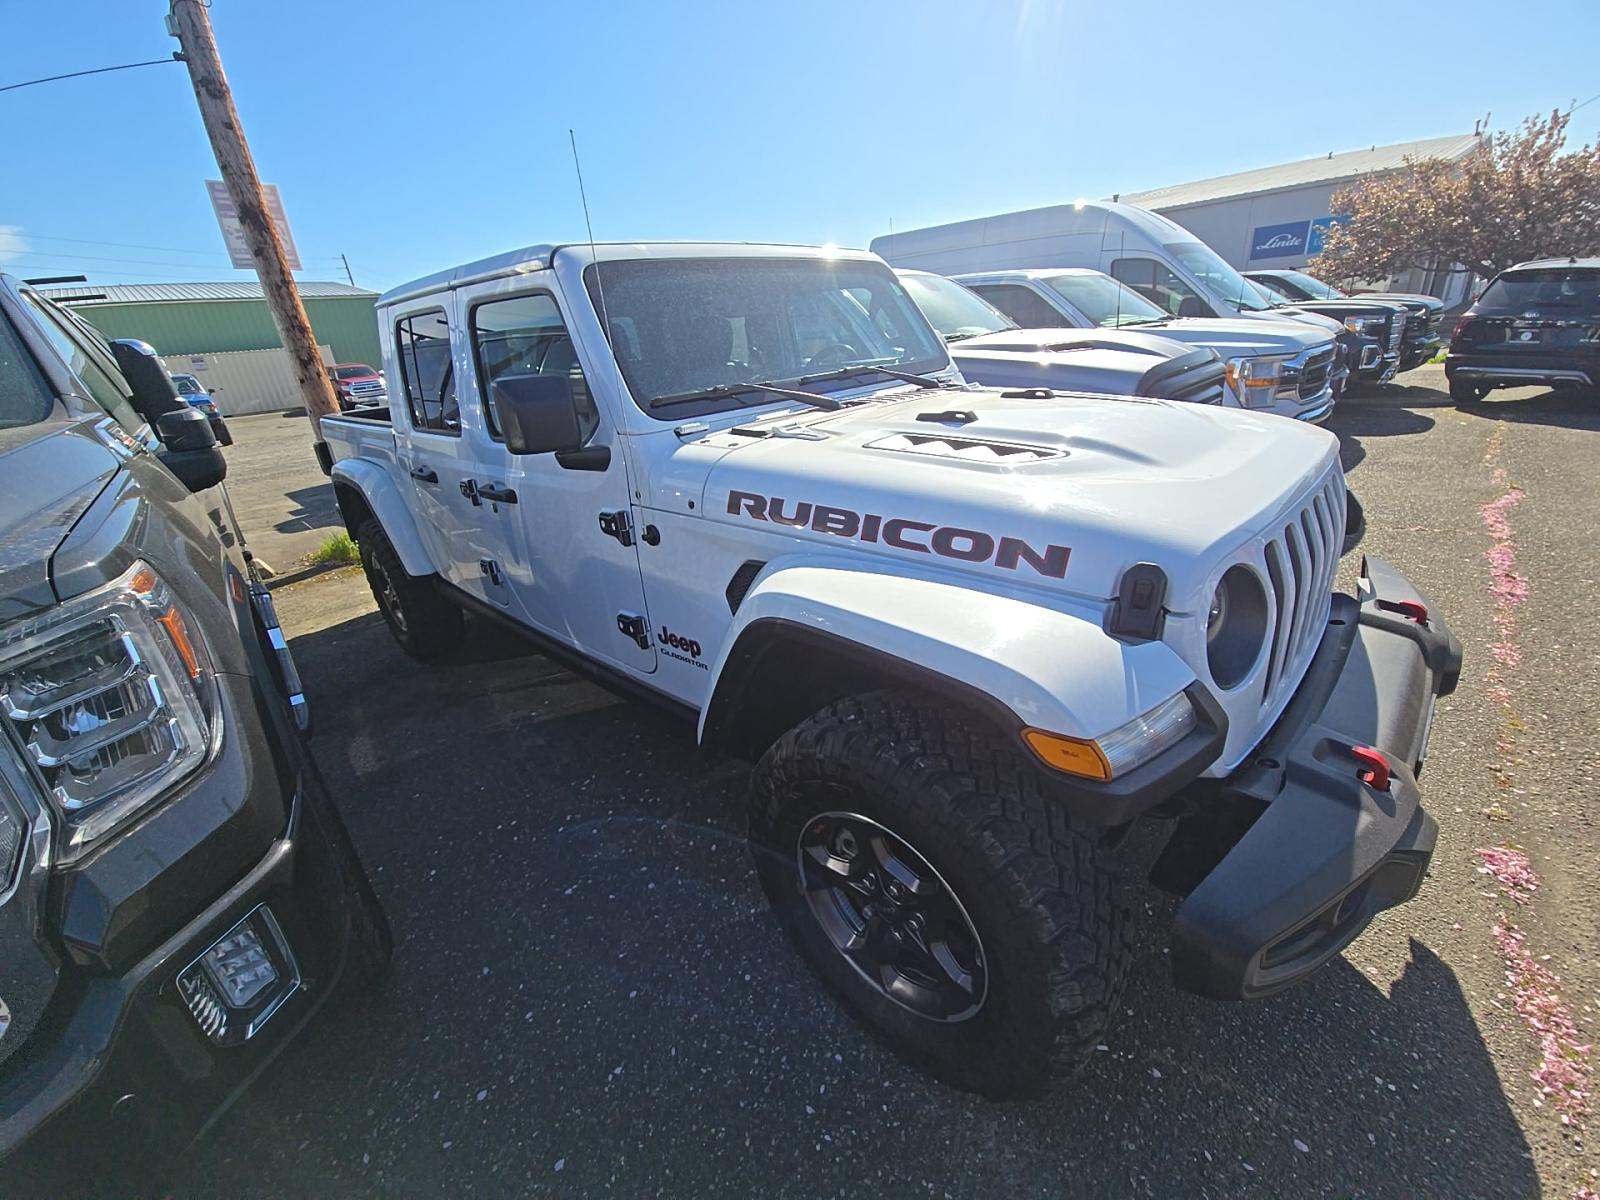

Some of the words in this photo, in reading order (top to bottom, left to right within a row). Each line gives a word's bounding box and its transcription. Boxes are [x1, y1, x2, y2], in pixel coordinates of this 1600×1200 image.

[1256, 233, 1302, 250] Linde
[726, 489, 1073, 579] RUBICON
[657, 625, 702, 659] Jeep
[660, 647, 709, 671] GLADIATOR
